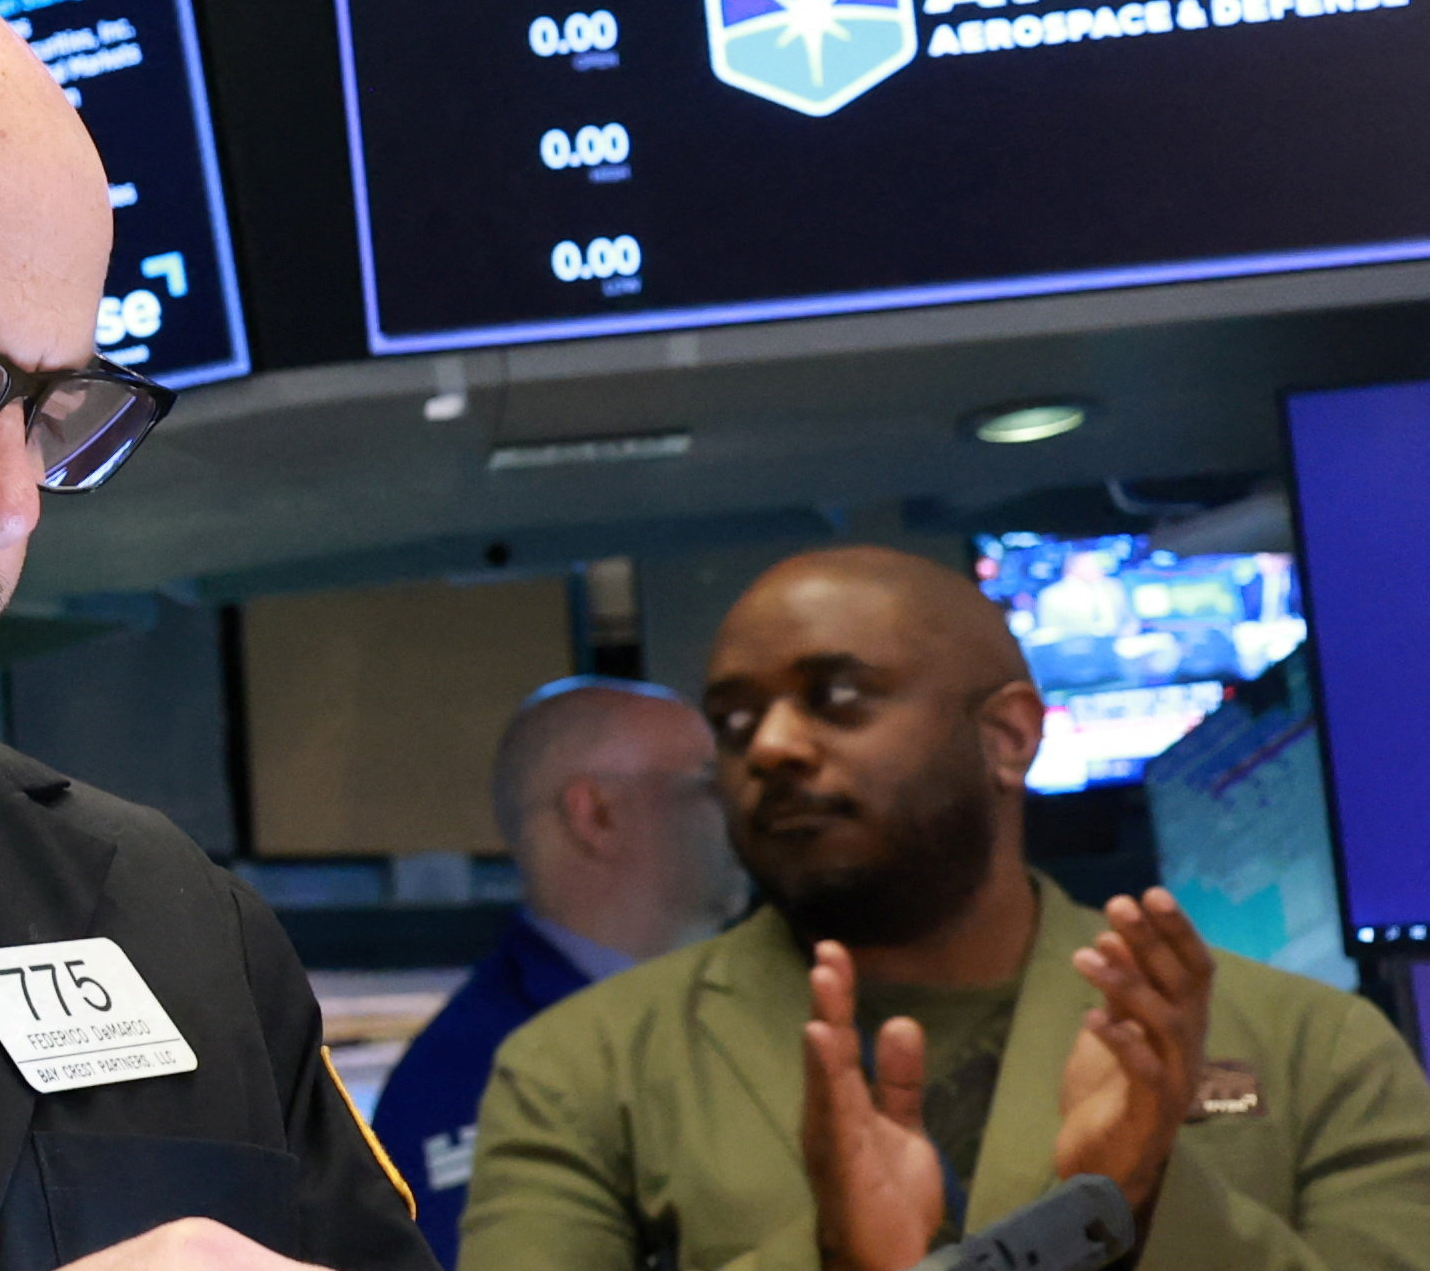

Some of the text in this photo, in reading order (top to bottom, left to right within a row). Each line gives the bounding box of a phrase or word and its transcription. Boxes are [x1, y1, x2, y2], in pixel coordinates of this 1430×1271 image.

[528, 9, 618, 57] 0.00
[927, 0, 1173, 57] AEROSPACE
[540, 122, 630, 170] 0.00
[551, 234, 641, 282] 0.00
[27, 1019, 151, 1050] FEDERICO DeMARCO
[37, 1068, 60, 1083] BAY
[62, 1064, 98, 1079] CREST
[154, 1050, 177, 1065] LLC
